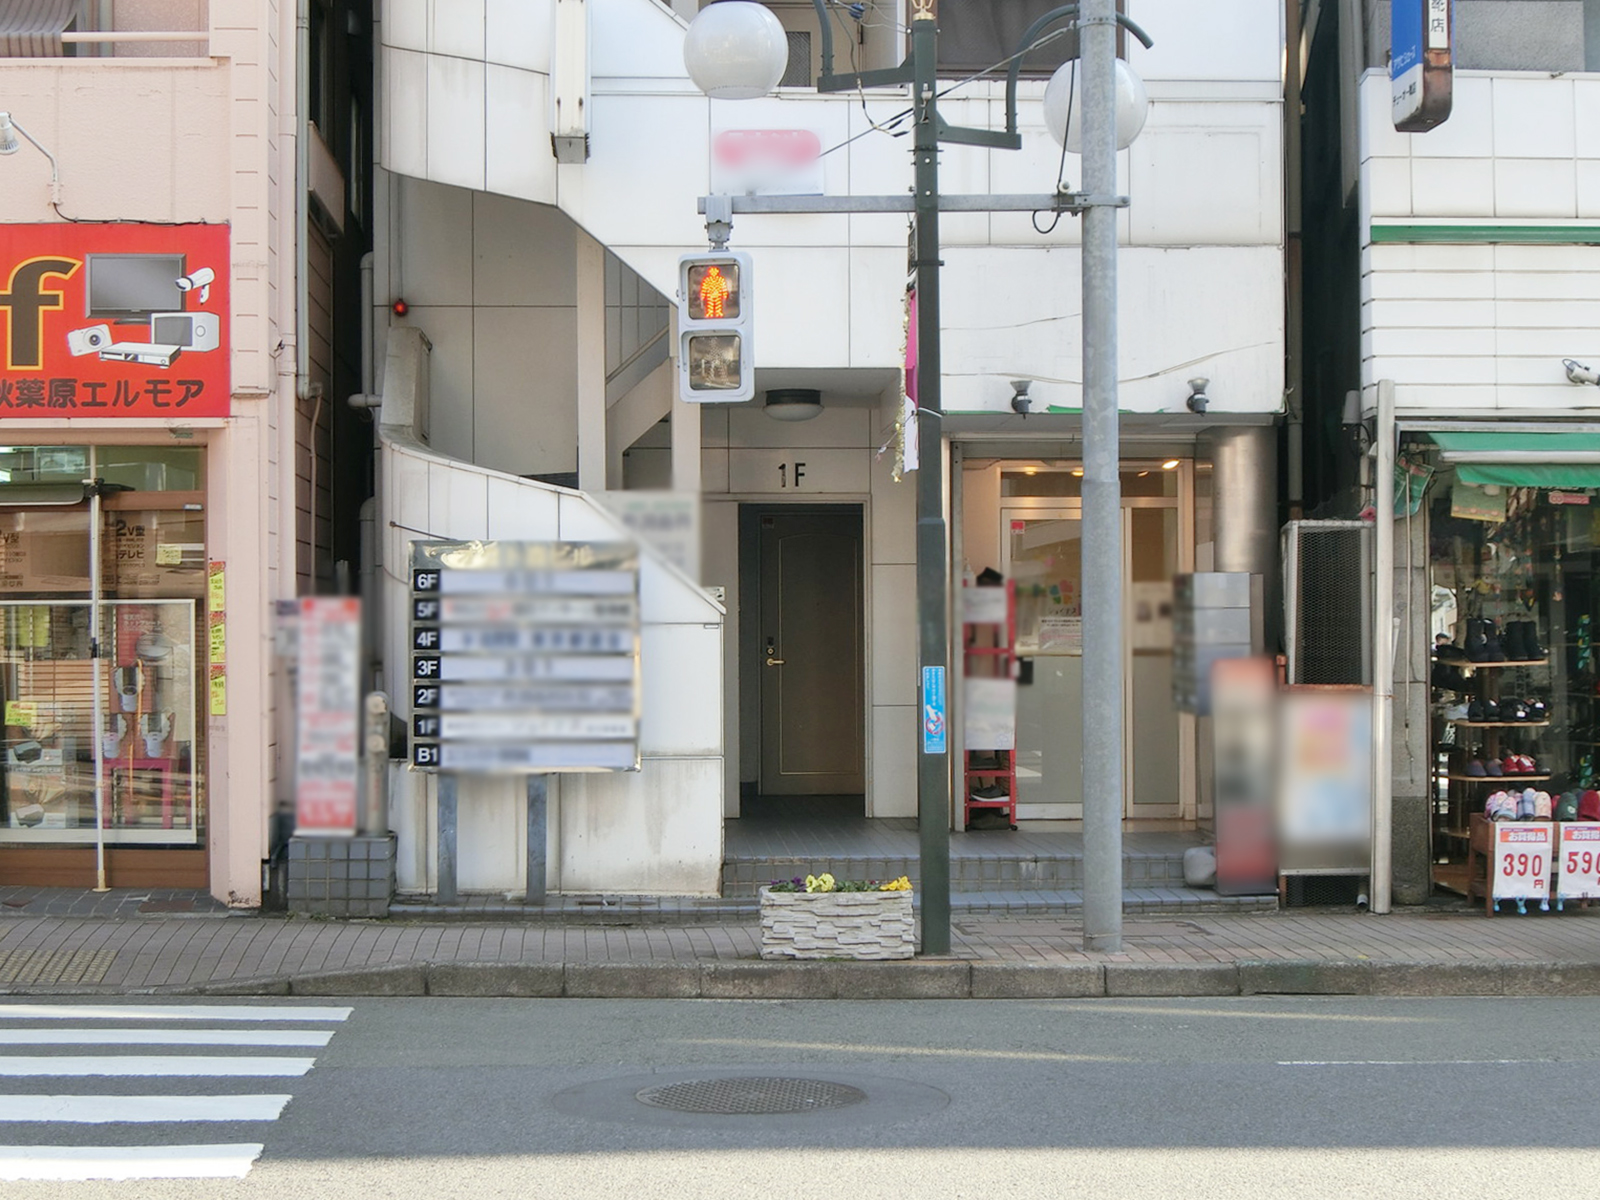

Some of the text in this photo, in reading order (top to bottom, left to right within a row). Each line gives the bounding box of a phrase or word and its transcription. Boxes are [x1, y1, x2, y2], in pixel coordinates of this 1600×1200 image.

[778, 462, 806, 488] 1F
[417, 573, 438, 589] 6F
[417, 601, 437, 618] 5F
[416, 631, 437, 647] 4F
[417, 660, 438, 676] 3F
[417, 688, 437, 704] 2F
[417, 719, 437, 735] 1F
[417, 746, 438, 763] B1
[1503, 853, 1543, 877] 390
[1534, 879, 1544, 889] 円
